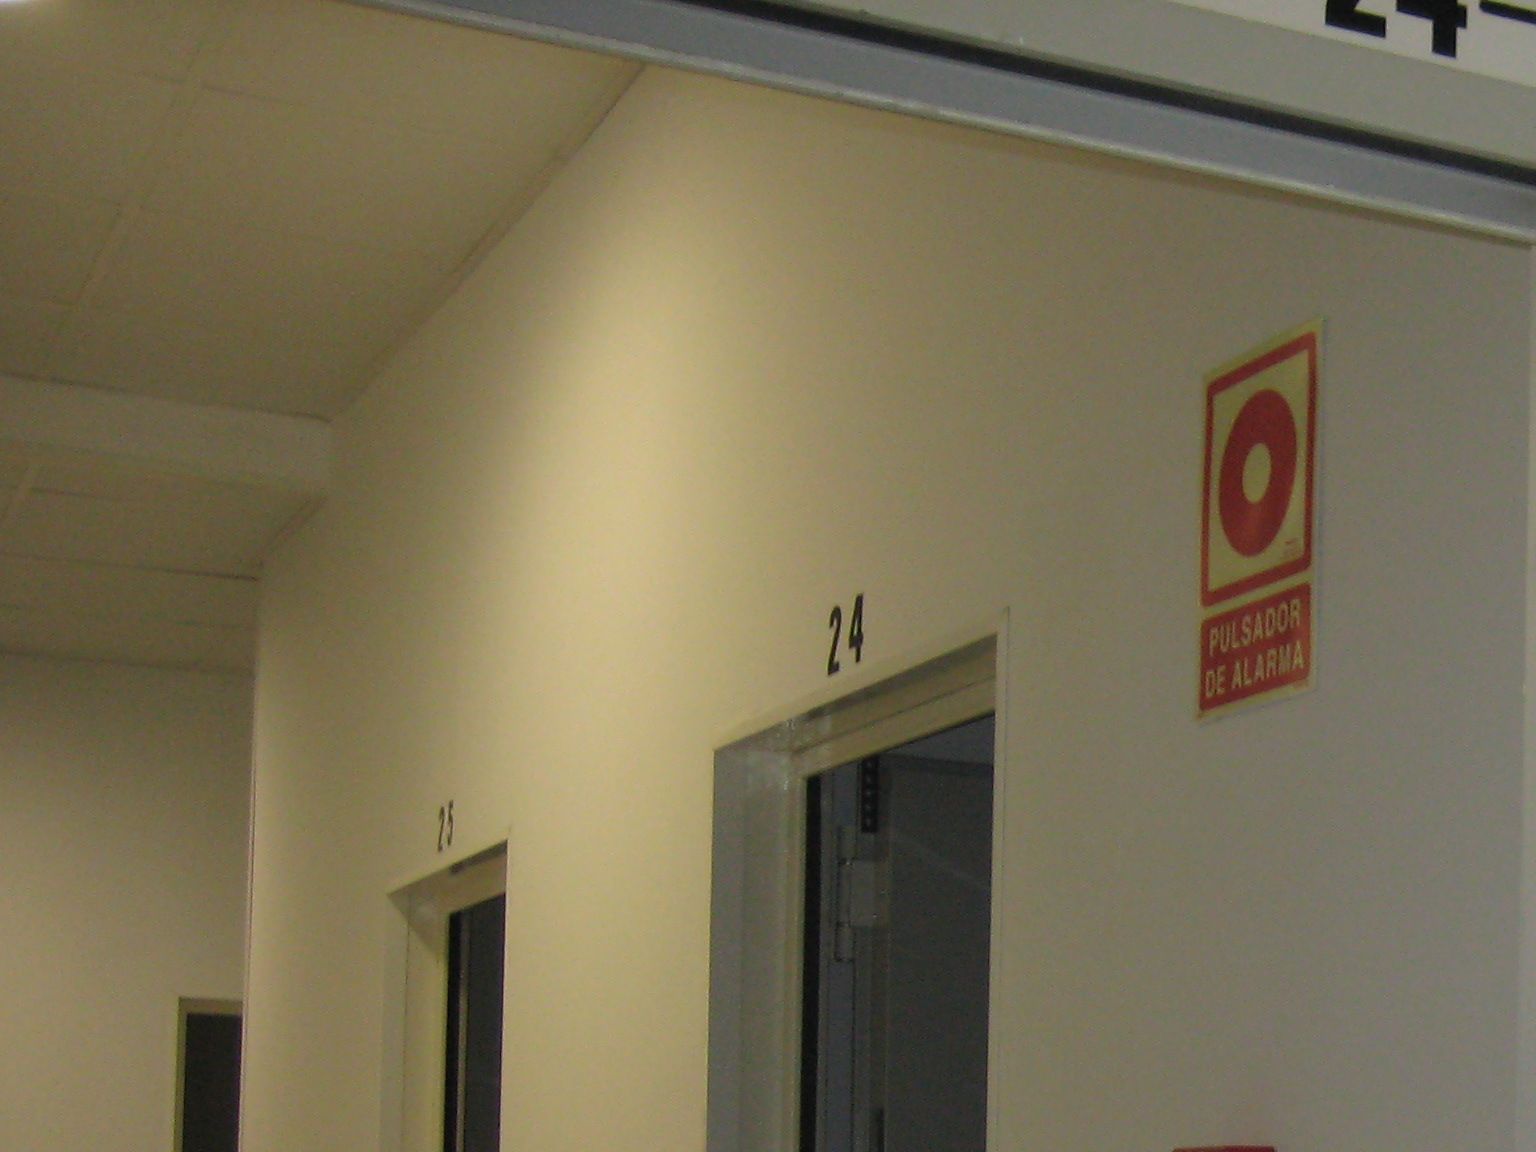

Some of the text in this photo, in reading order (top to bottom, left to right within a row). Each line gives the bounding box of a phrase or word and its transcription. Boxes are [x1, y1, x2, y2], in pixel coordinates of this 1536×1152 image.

[827, 593, 864, 676] 24
[1208, 599, 1301, 657] PULSADOR
[1205, 640, 1304, 698] DE ALARMA
